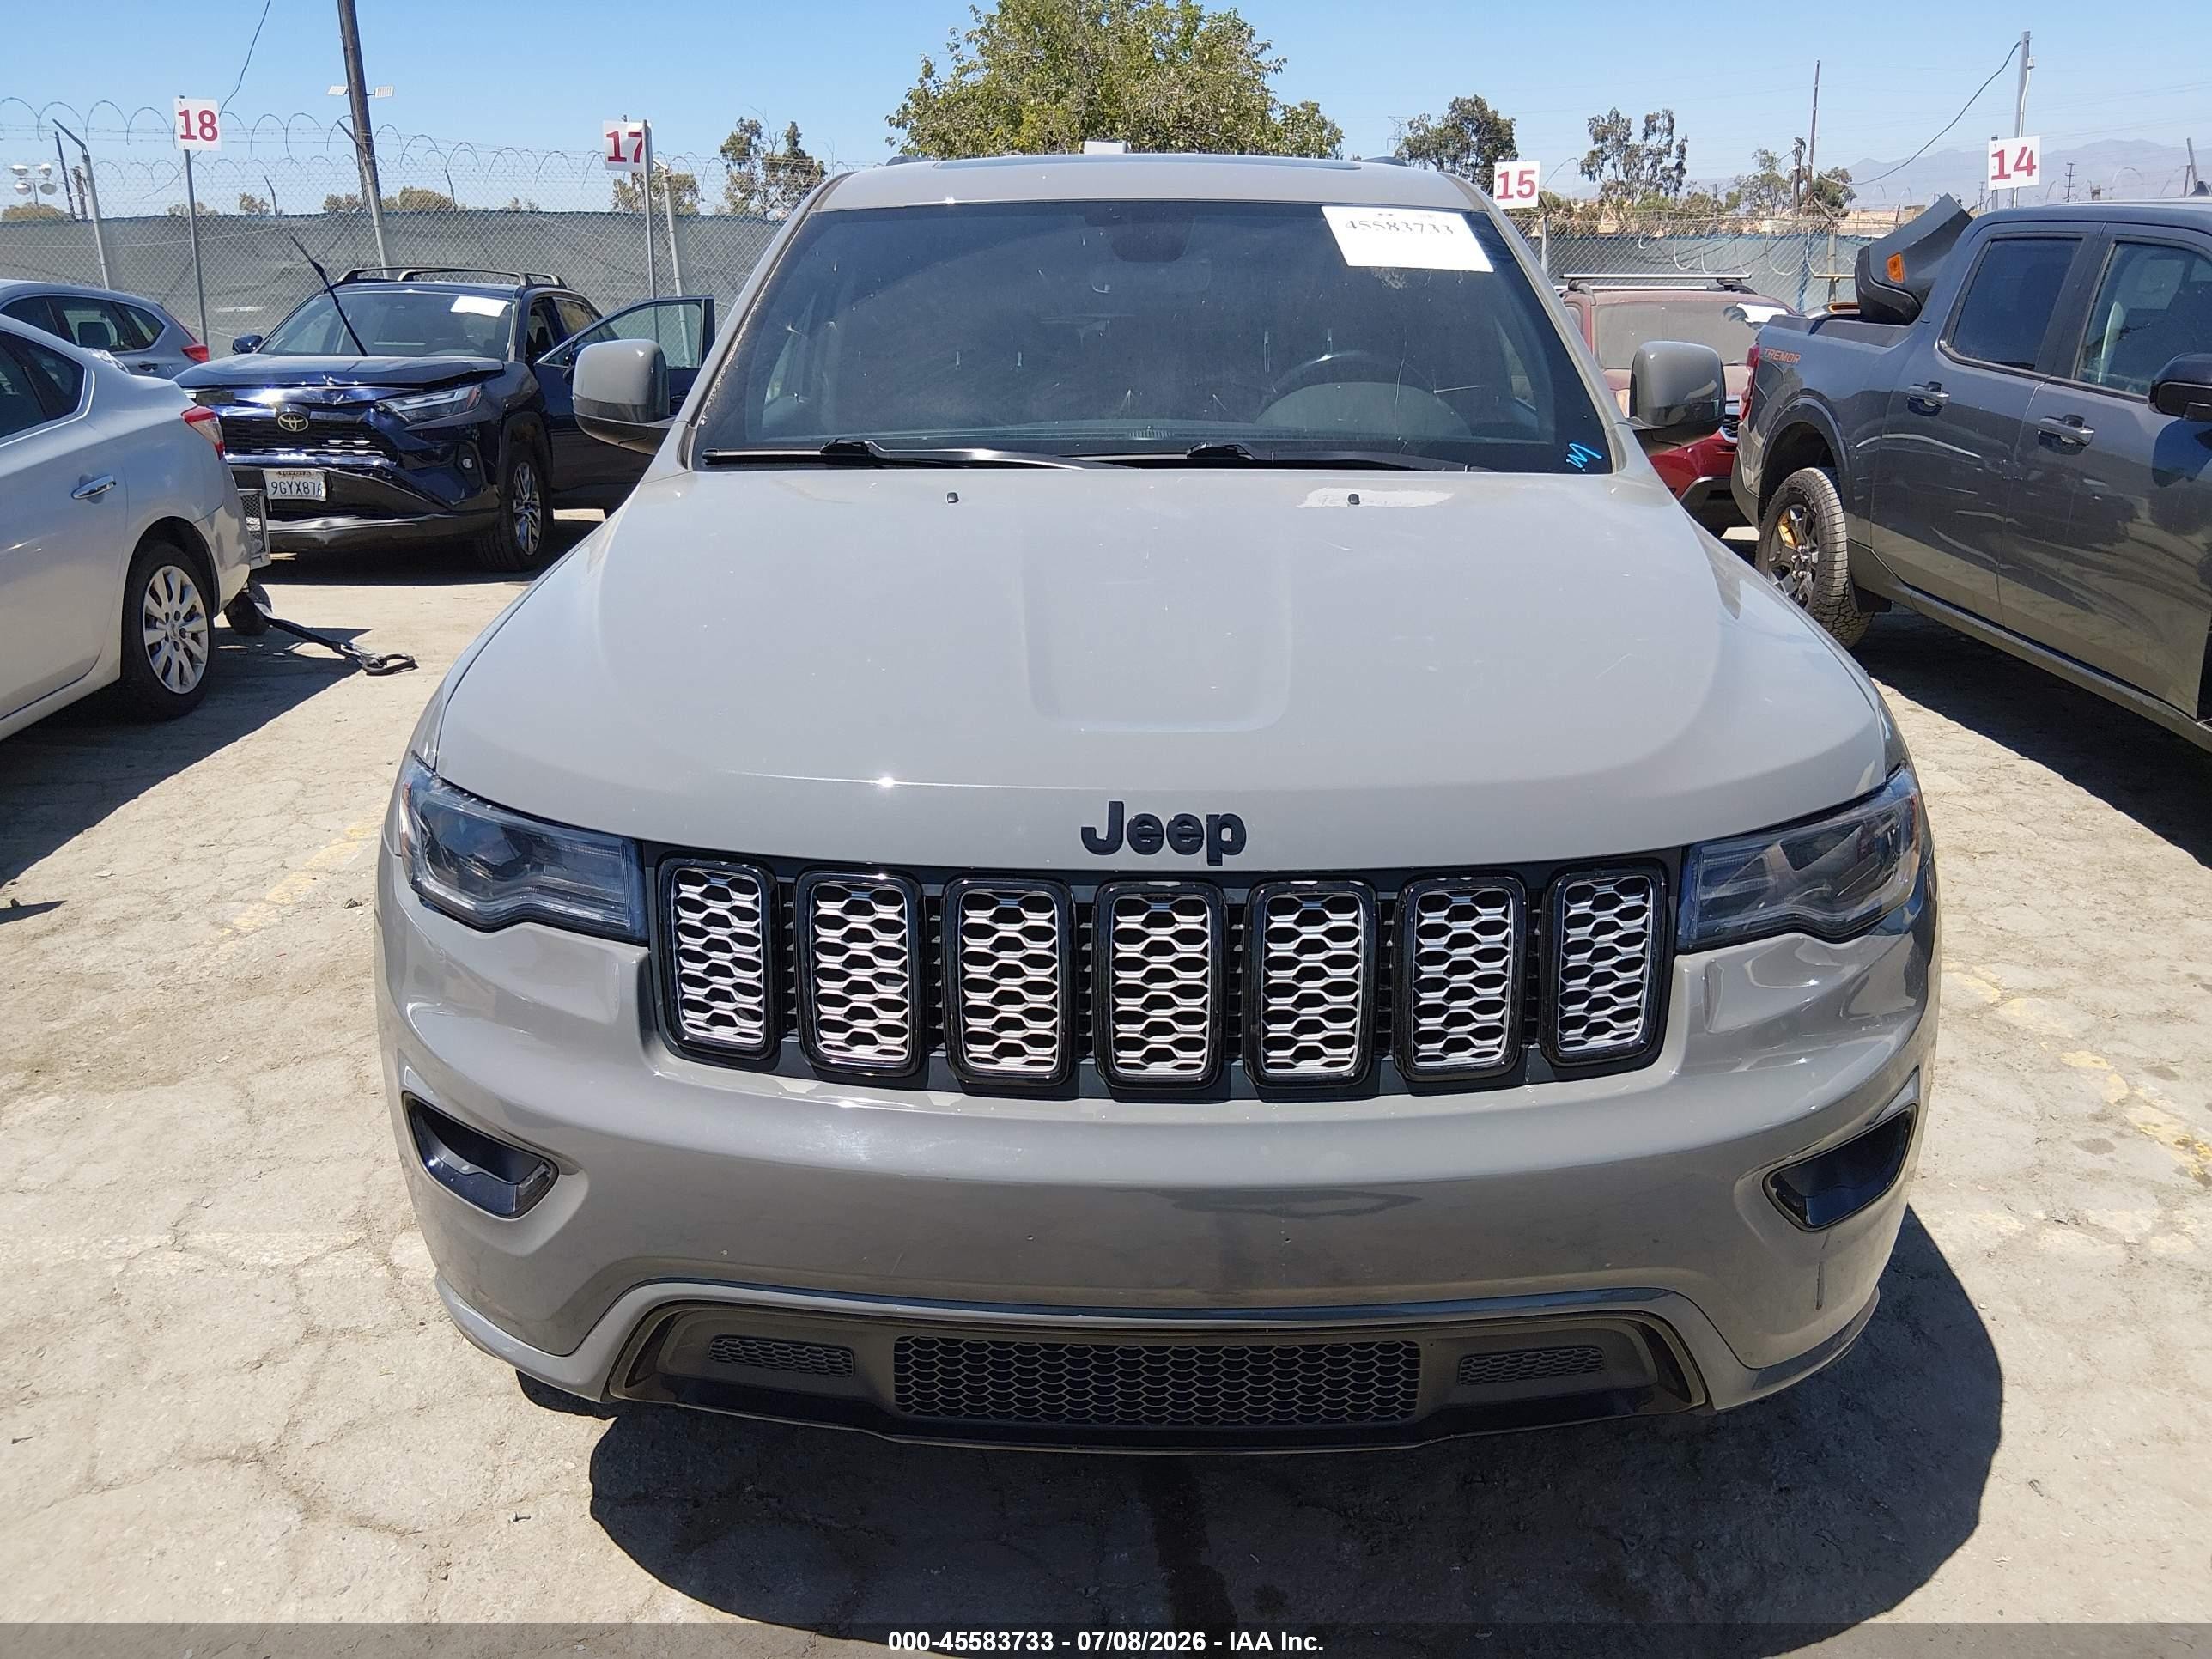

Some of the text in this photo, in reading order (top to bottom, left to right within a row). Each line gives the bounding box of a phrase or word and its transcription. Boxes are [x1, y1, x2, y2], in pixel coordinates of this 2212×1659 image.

[178, 109, 218, 142] 18
[606, 131, 643, 164] 17
[1991, 146, 2037, 180] 14
[1497, 170, 1535, 199] 15
[1345, 219, 1455, 235] 45583733
[1765, 347, 1801, 364] TREMOR
[270, 481, 323, 496] 9GYX876
[1081, 800, 1247, 866] Jeep
